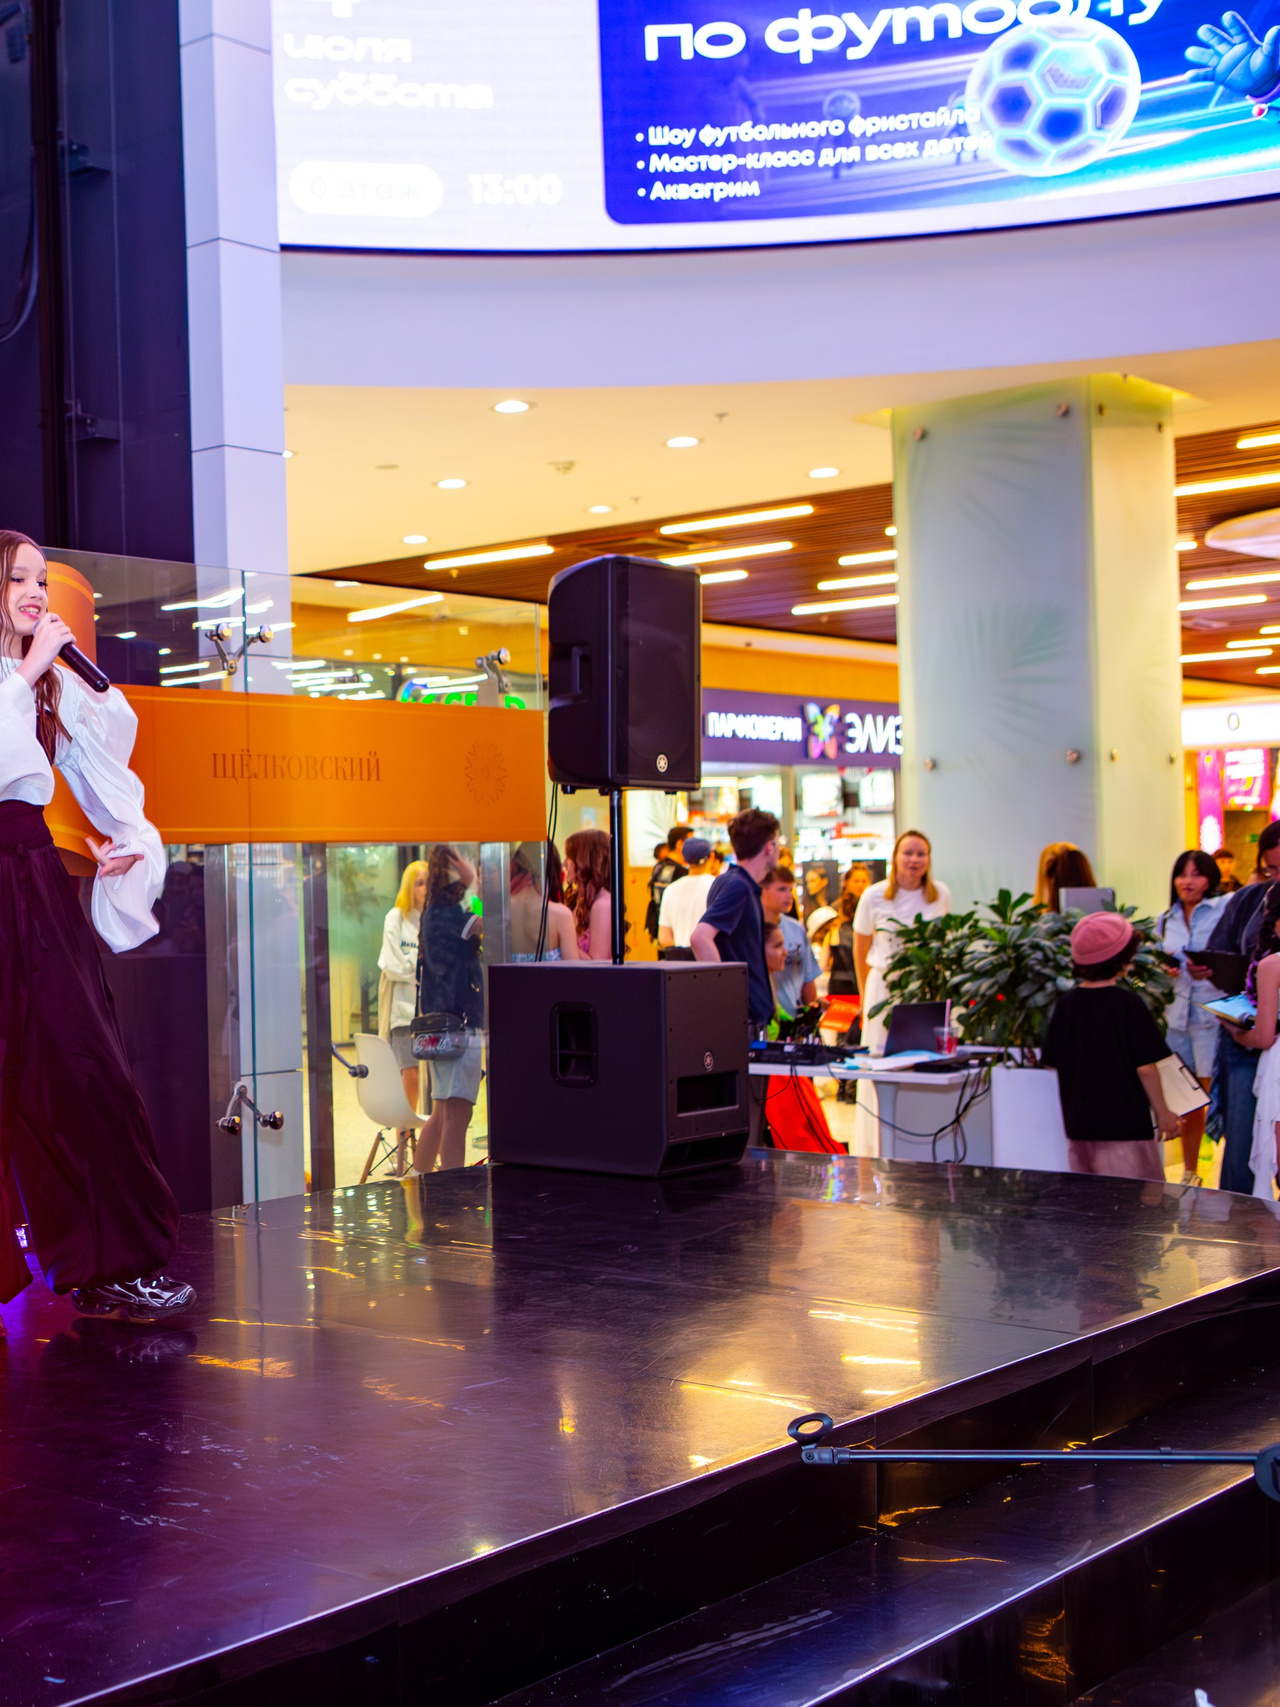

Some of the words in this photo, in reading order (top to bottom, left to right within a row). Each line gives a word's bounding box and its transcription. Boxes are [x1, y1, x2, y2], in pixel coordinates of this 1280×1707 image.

[643, 21, 747, 61] по
[284, 72, 494, 110] суббота
[648, 125, 697, 149] Шоу
[698, 118, 846, 148] футбольного
[847, 106, 981, 138] фристайла
[648, 149, 816, 175] Мастер-класс
[818, 146, 861, 168] для
[865, 141, 920, 162] всех
[922, 130, 993, 159] детей
[467, 172, 564, 206] 13:00
[649, 180, 761, 203] Аквагрим
[707, 711, 803, 743] ПАРФЮМЕРИЯ
[212, 748, 381, 785] ЩЁЛКОВСКИЙ
